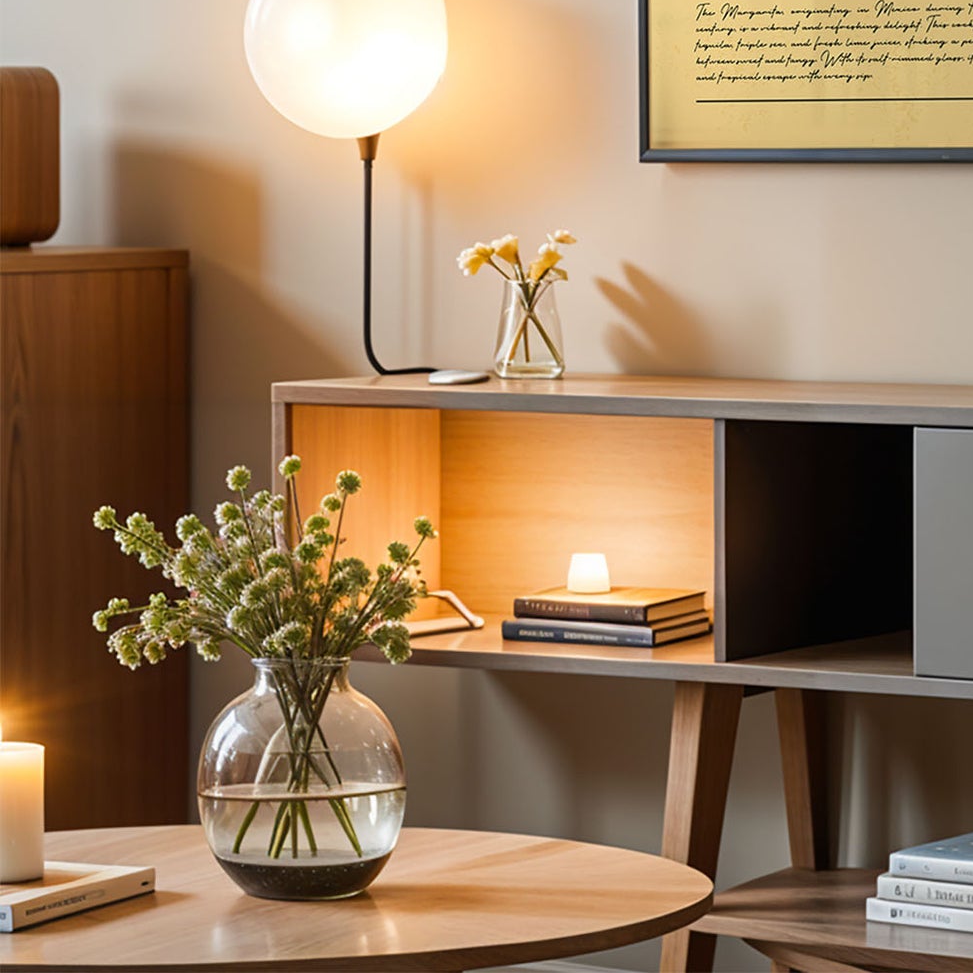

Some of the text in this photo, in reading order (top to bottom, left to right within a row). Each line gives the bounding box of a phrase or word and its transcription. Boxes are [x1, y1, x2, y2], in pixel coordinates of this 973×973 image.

[696, 2, 716, 21] The
[791, 4, 852, 18] originating
[874, 0, 921, 18] Mexico
[925, 3, 965, 16] during
[760, 21, 801, 35] vibrant
[801, 22, 823, 31] and
[824, 19, 881, 34] refreshing
[926, 14, 949, 33] This
[735, 38, 767, 51] triple
[790, 38, 812, 47] and
[813, 35, 843, 51] fresh
[845, 38, 871, 46] lime
[904, 35, 947, 49] striking
[696, 55, 737, 68] between
[736, 53, 764, 67] sweet
[765, 55, 786, 64] and
[820, 49, 854, 68] With
[696, 72, 717, 81] and
[716, 71, 761, 84] tropical
[798, 69, 822, 83] with
